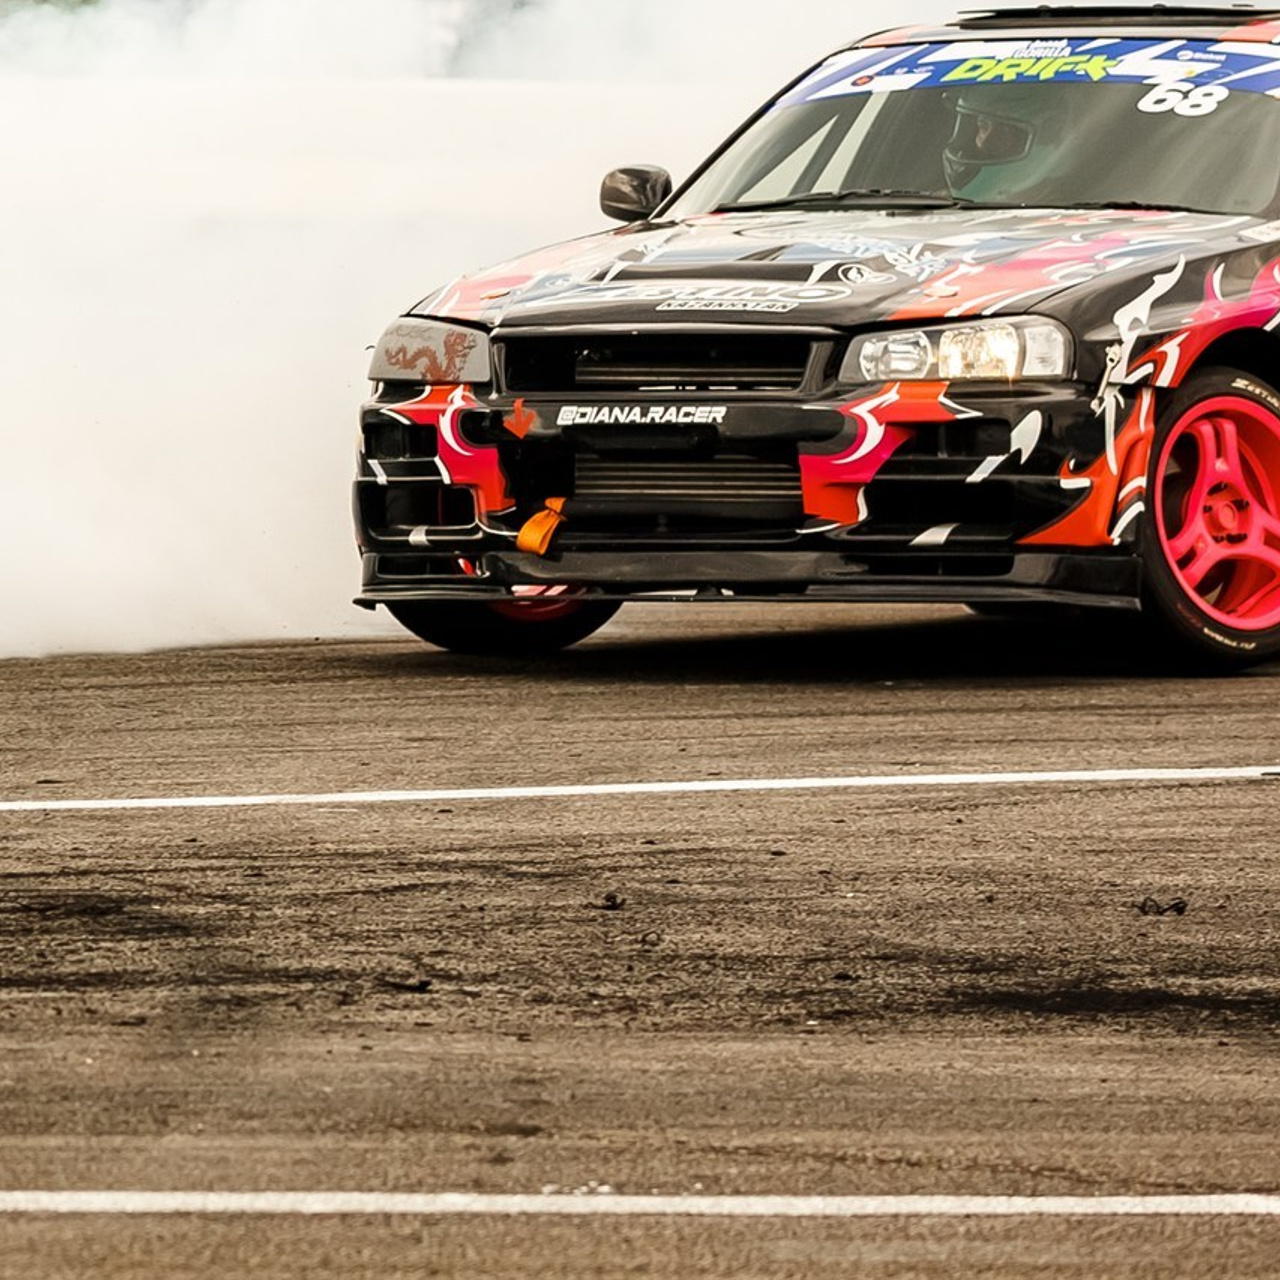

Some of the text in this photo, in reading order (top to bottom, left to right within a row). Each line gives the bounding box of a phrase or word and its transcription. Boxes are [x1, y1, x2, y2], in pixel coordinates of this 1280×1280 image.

[939, 54, 1119, 82] DRIFT
[1137, 81, 1229, 117] 68
[556, 406, 727, 425] @DIANA.RACER
